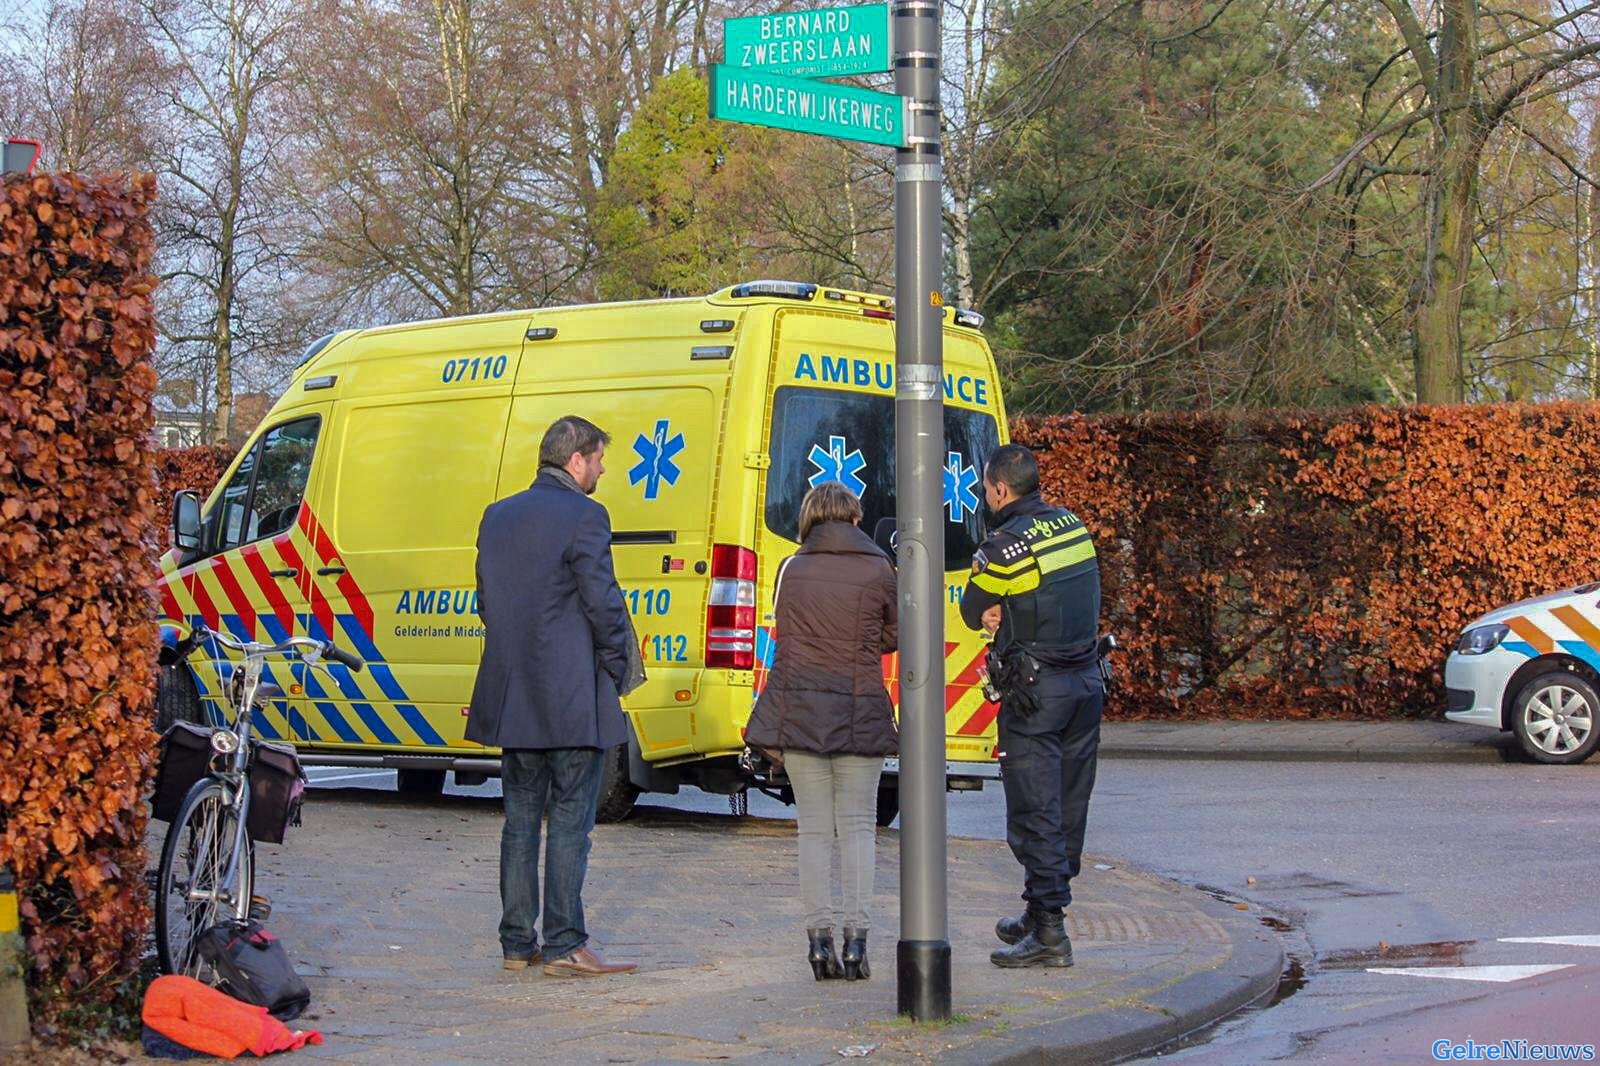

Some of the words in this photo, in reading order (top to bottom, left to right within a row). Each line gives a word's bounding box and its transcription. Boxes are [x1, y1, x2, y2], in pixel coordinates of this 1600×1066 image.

[761, 10, 850, 40] BERNARD
[742, 33, 871, 67] ZWEERSLAAN
[727, 80, 893, 132] HARDERWIJKERWEG
[442, 355, 507, 383] 07110
[794, 353, 988, 405] AMBUNCE
[395, 626, 450, 637] Gelderland
